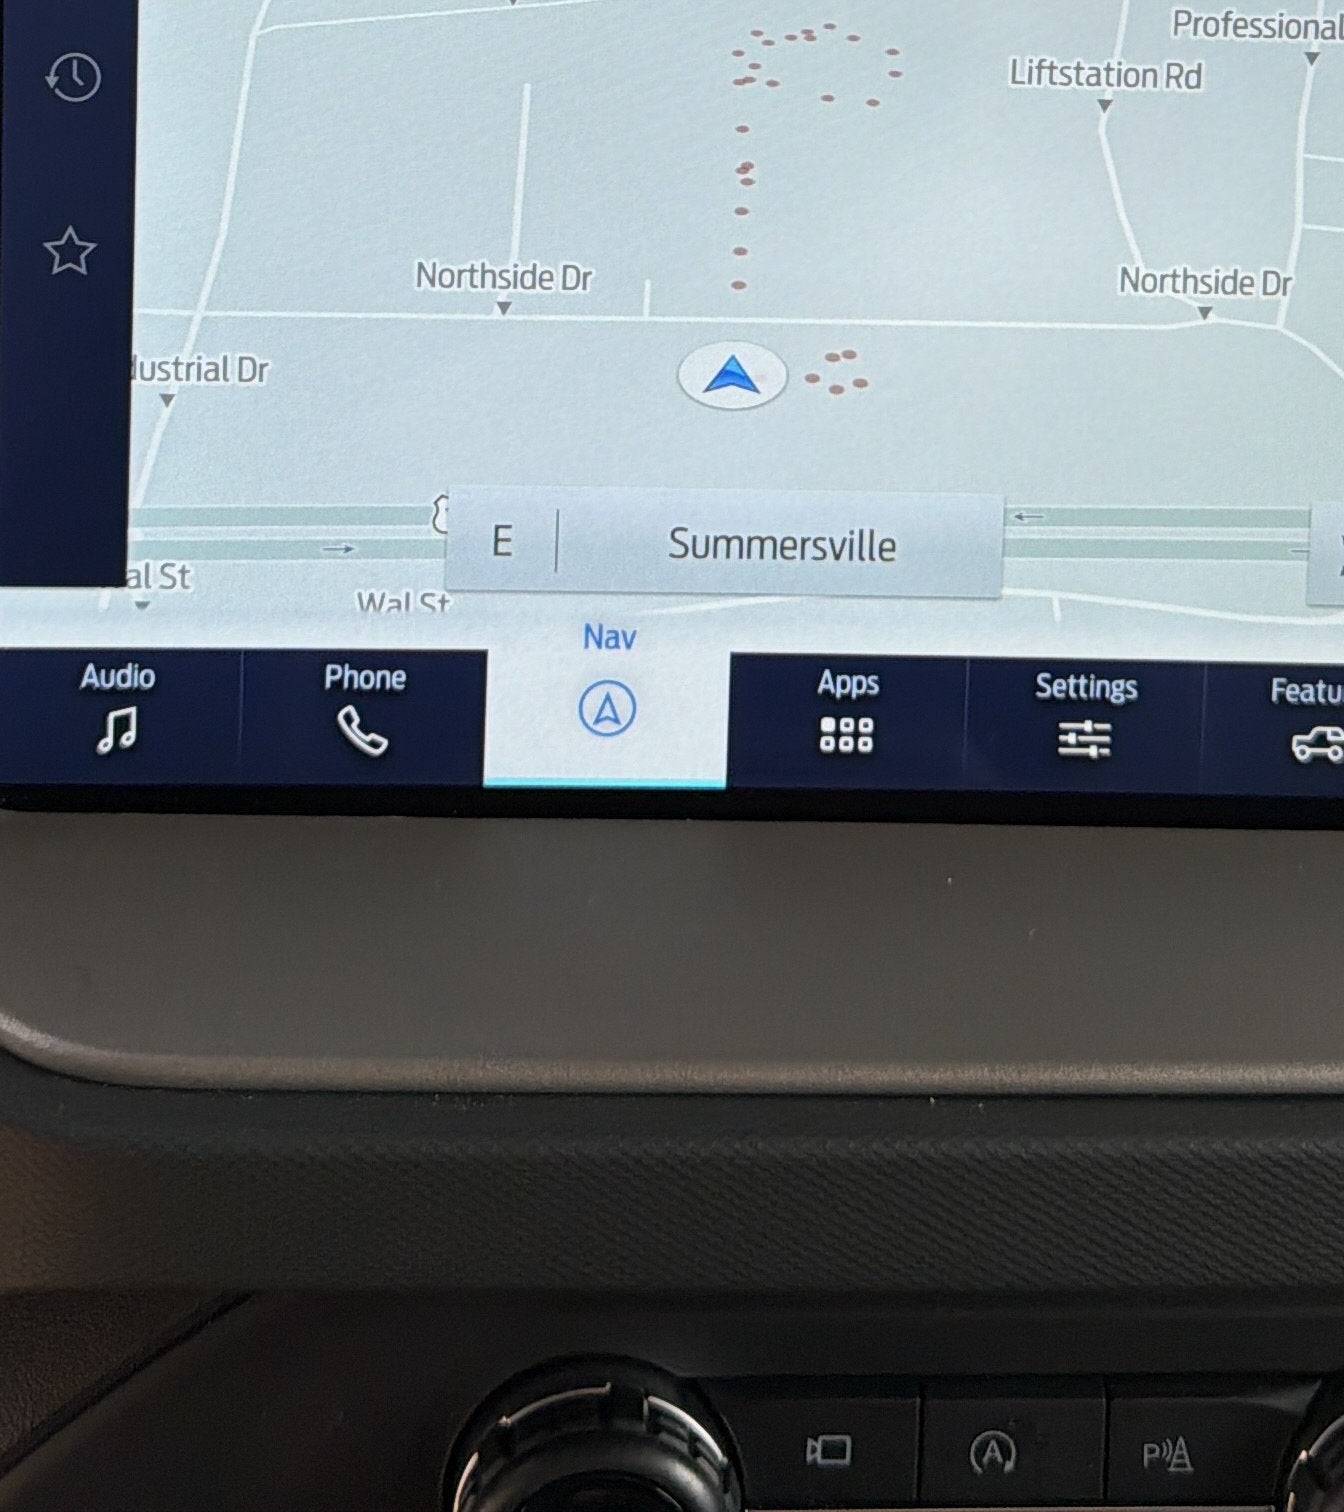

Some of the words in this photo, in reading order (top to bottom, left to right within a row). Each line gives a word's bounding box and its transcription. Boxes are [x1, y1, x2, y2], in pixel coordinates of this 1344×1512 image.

[1010, 58, 1159, 89] Liftstation
[1165, 62, 1202, 90] Rd
[416, 262, 555, 291] Northside
[561, 264, 593, 293] Dr
[1119, 267, 1256, 295] Northside
[1262, 270, 1293, 297] Dr
[238, 356, 269, 382] Dr
[492, 525, 513, 557] E
[668, 527, 897, 562] Summersville
[159, 562, 191, 589] St
[584, 625, 637, 650] Nav
[81, 664, 156, 690] Audio
[325, 664, 407, 690] Phone
[817, 669, 880, 699] Apps
[1036, 673, 1139, 704] Settings
